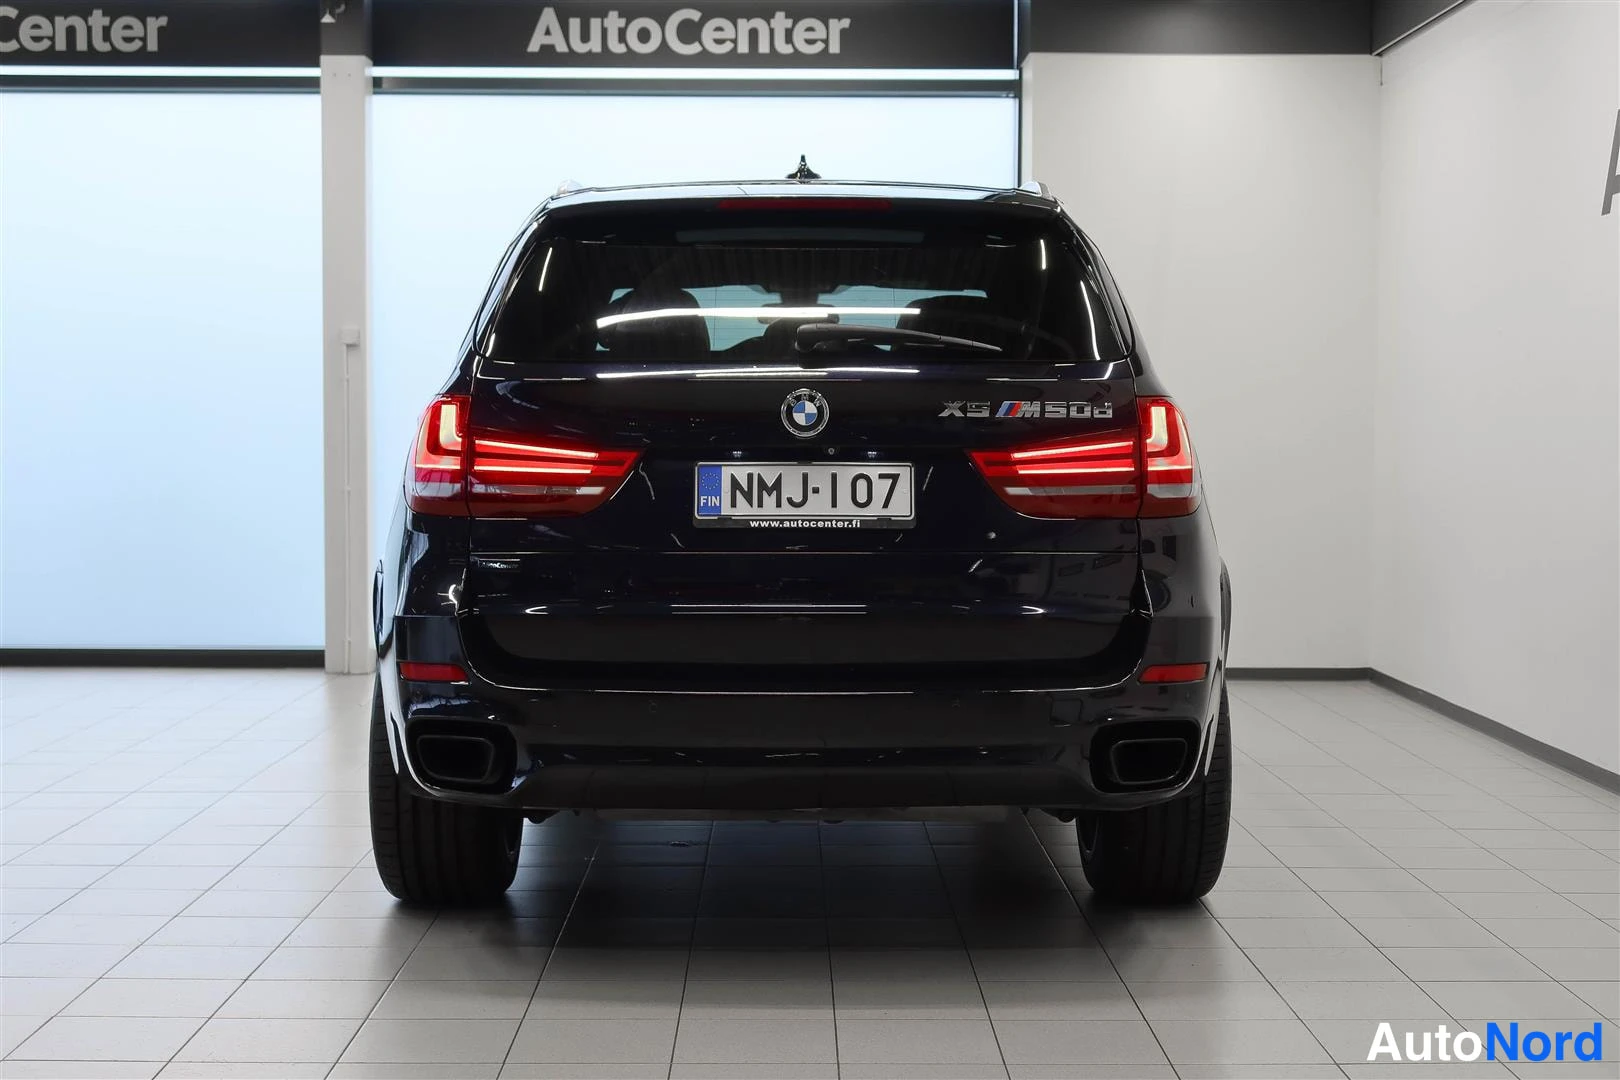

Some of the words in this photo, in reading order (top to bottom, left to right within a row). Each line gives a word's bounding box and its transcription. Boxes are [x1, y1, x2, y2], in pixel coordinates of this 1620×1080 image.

[527, 7, 851, 55] AutoCenter
[938, 401, 990, 418] X5
[700, 495, 720, 507] FIN
[750, 519, 861, 528] www.autocenter.fi
